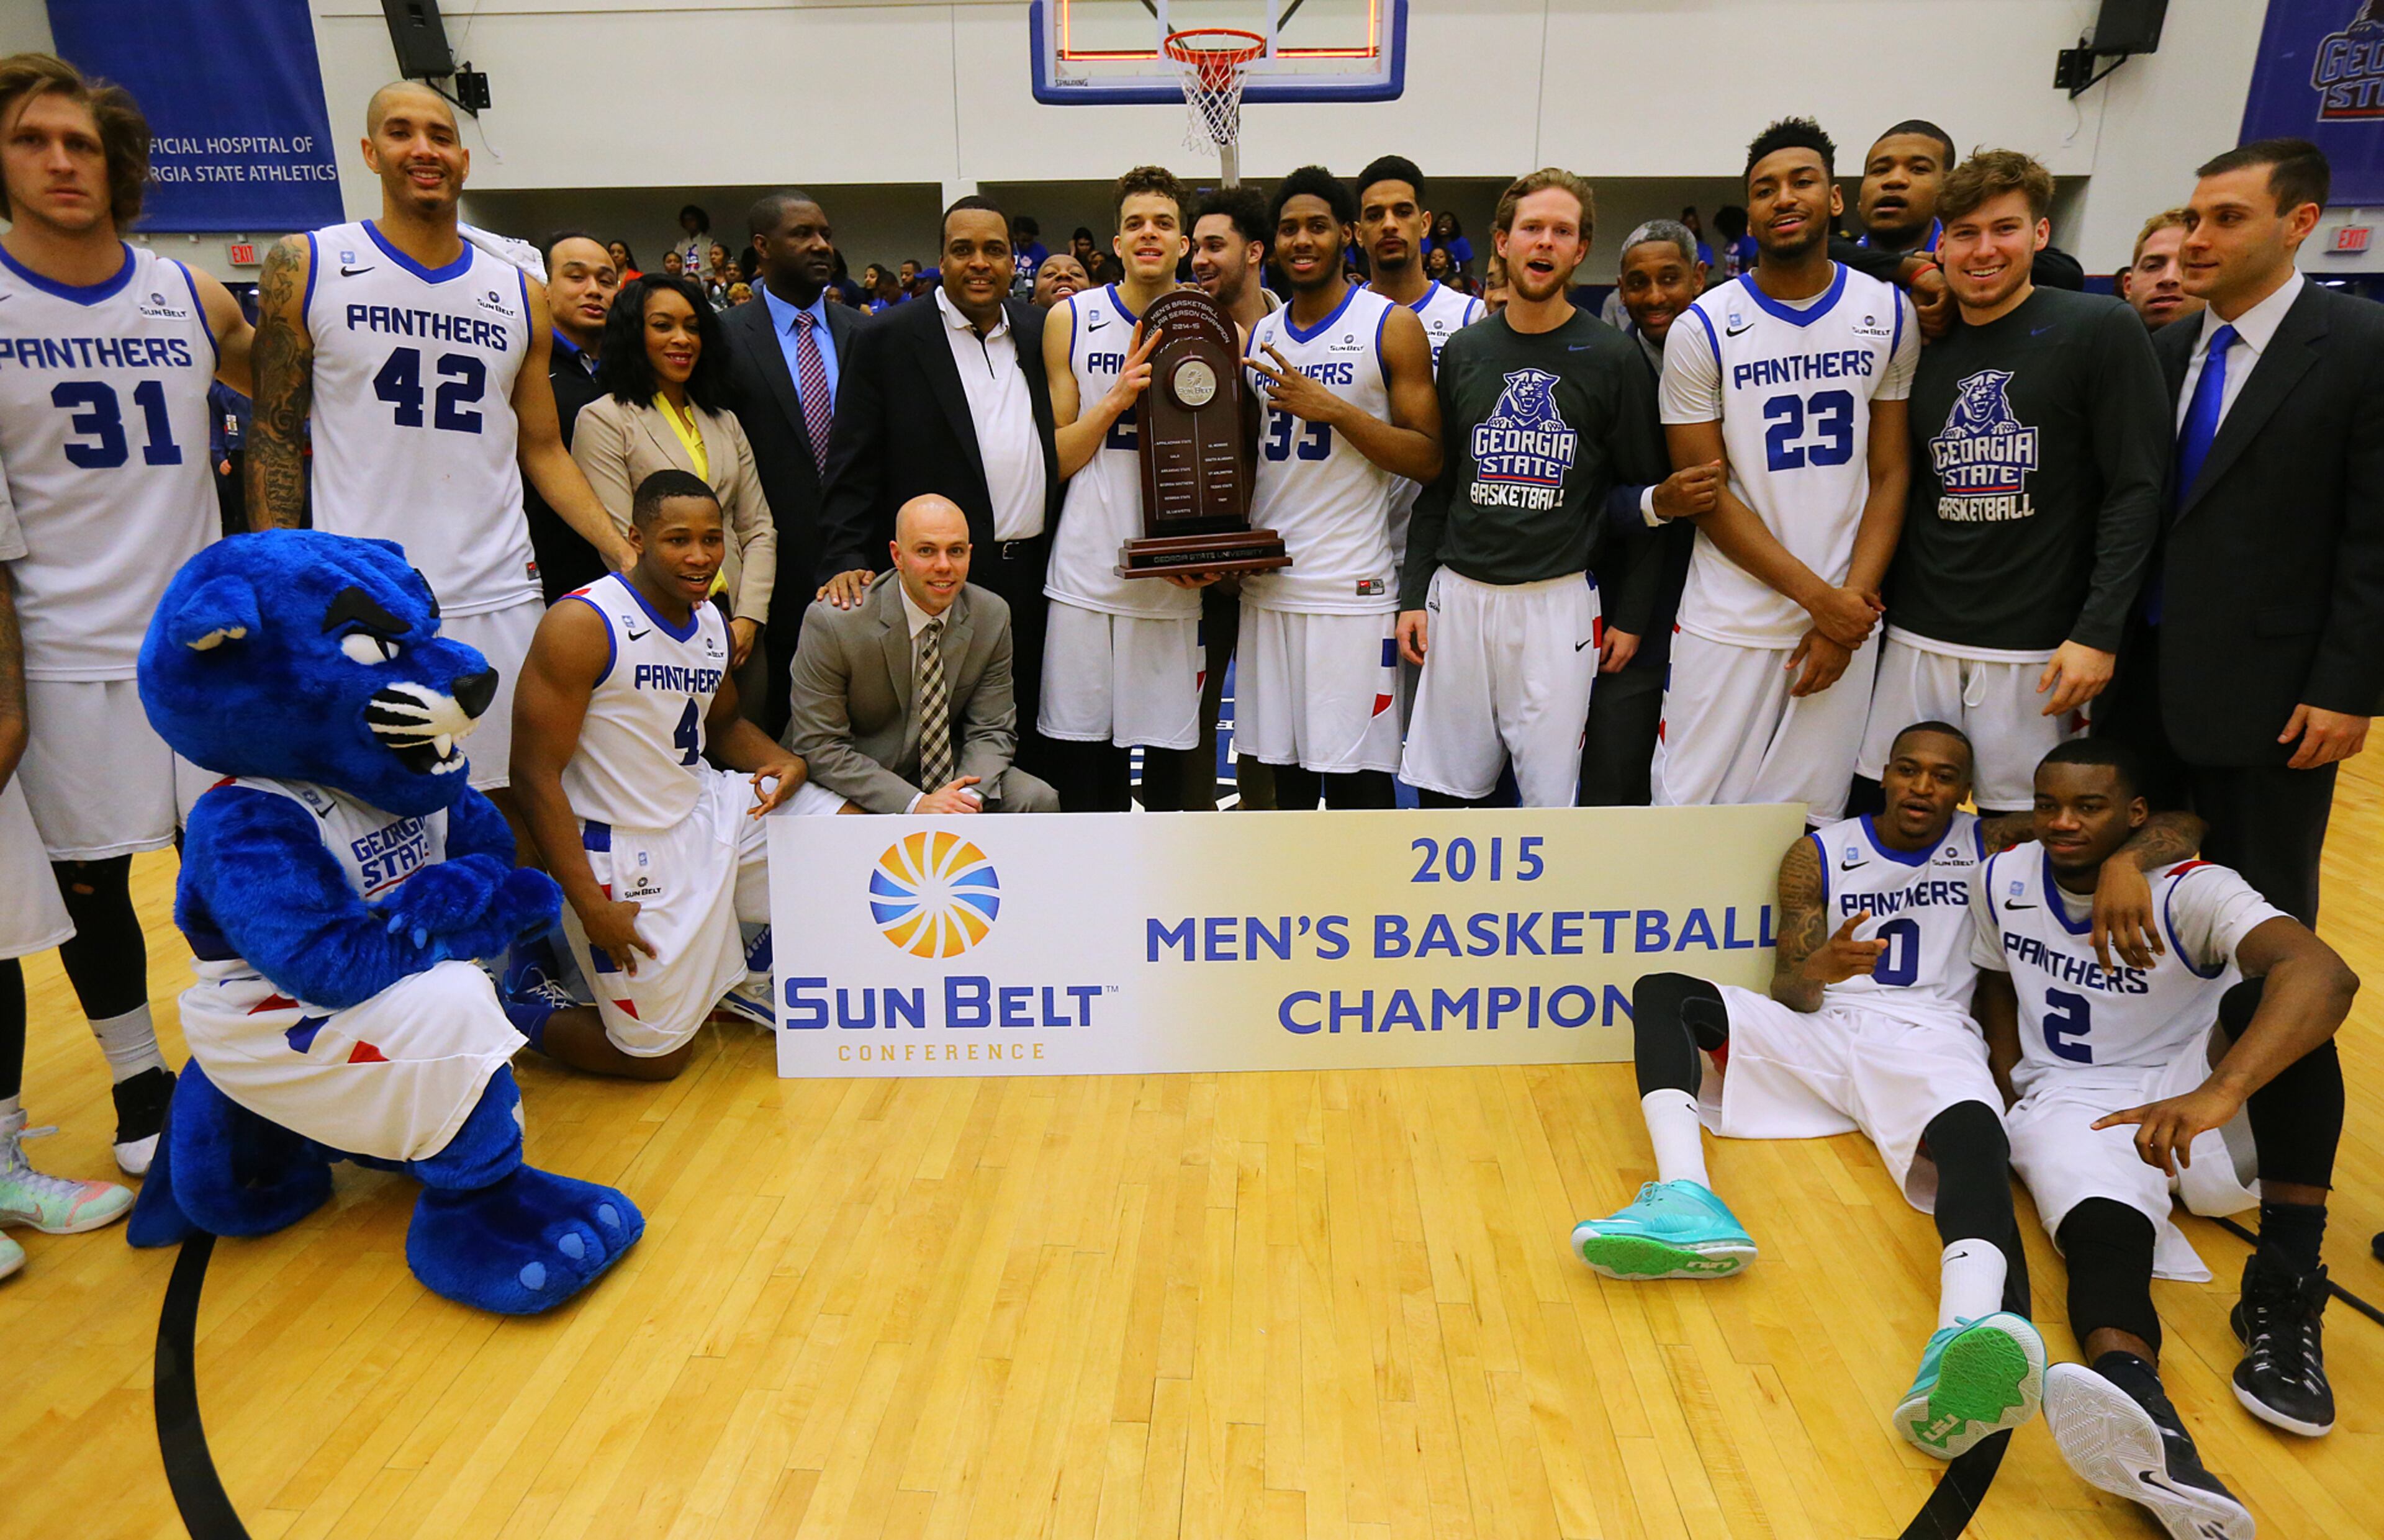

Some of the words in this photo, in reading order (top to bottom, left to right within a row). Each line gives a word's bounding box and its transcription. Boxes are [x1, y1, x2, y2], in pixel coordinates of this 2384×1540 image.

[149, 138, 203, 154] FICIAL
[206, 137, 290, 153] HOSPITAL
[292, 137, 313, 153] OF
[150, 166, 192, 182] RGIA
[195, 165, 245, 182] STATE
[249, 164, 337, 181] ATHLETICS
[230, 245, 255, 263] EXIT
[2338, 228, 2370, 249] EXIT
[1150, 304, 1171, 322] MEN'S
[1172, 300, 1219, 320] BASKETBALL
[1168, 310, 1199, 318] SEASON
[1200, 312, 1230, 344] CHAMPION
[346, 304, 508, 352] PANTHERS
[1733, 349, 1875, 390] PANTHERS
[373, 346, 486, 435] 42
[51, 380, 183, 469] 31
[1763, 389, 1854, 472] 23
[1474, 430, 1575, 462] GEORGIA
[1932, 432, 2034, 469] GEORGIA
[1481, 455, 1560, 479] STATE
[1945, 464, 2019, 487] STATE
[1470, 482, 1564, 511] BASKETBALL
[1938, 493, 2035, 522] BASKETBALL
[1154, 554, 1188, 563] GEORGIA
[1189, 551, 1216, 561] STATE
[1216, 548, 1263, 559] UNIVERSITY
[634, 664, 723, 694] PANTHERS
[674, 697, 700, 766] 4
[1411, 836, 1545, 883] 2015
[1146, 914, 1351, 963] MEN'S
[1373, 904, 1776, 959] BASKETBALL
[1871, 918, 1920, 988] 0
[2003, 931, 2149, 994] PANTHERS
[2043, 986, 2093, 1065] 2
[838, 1043, 1045, 1061] CONFERENCE
